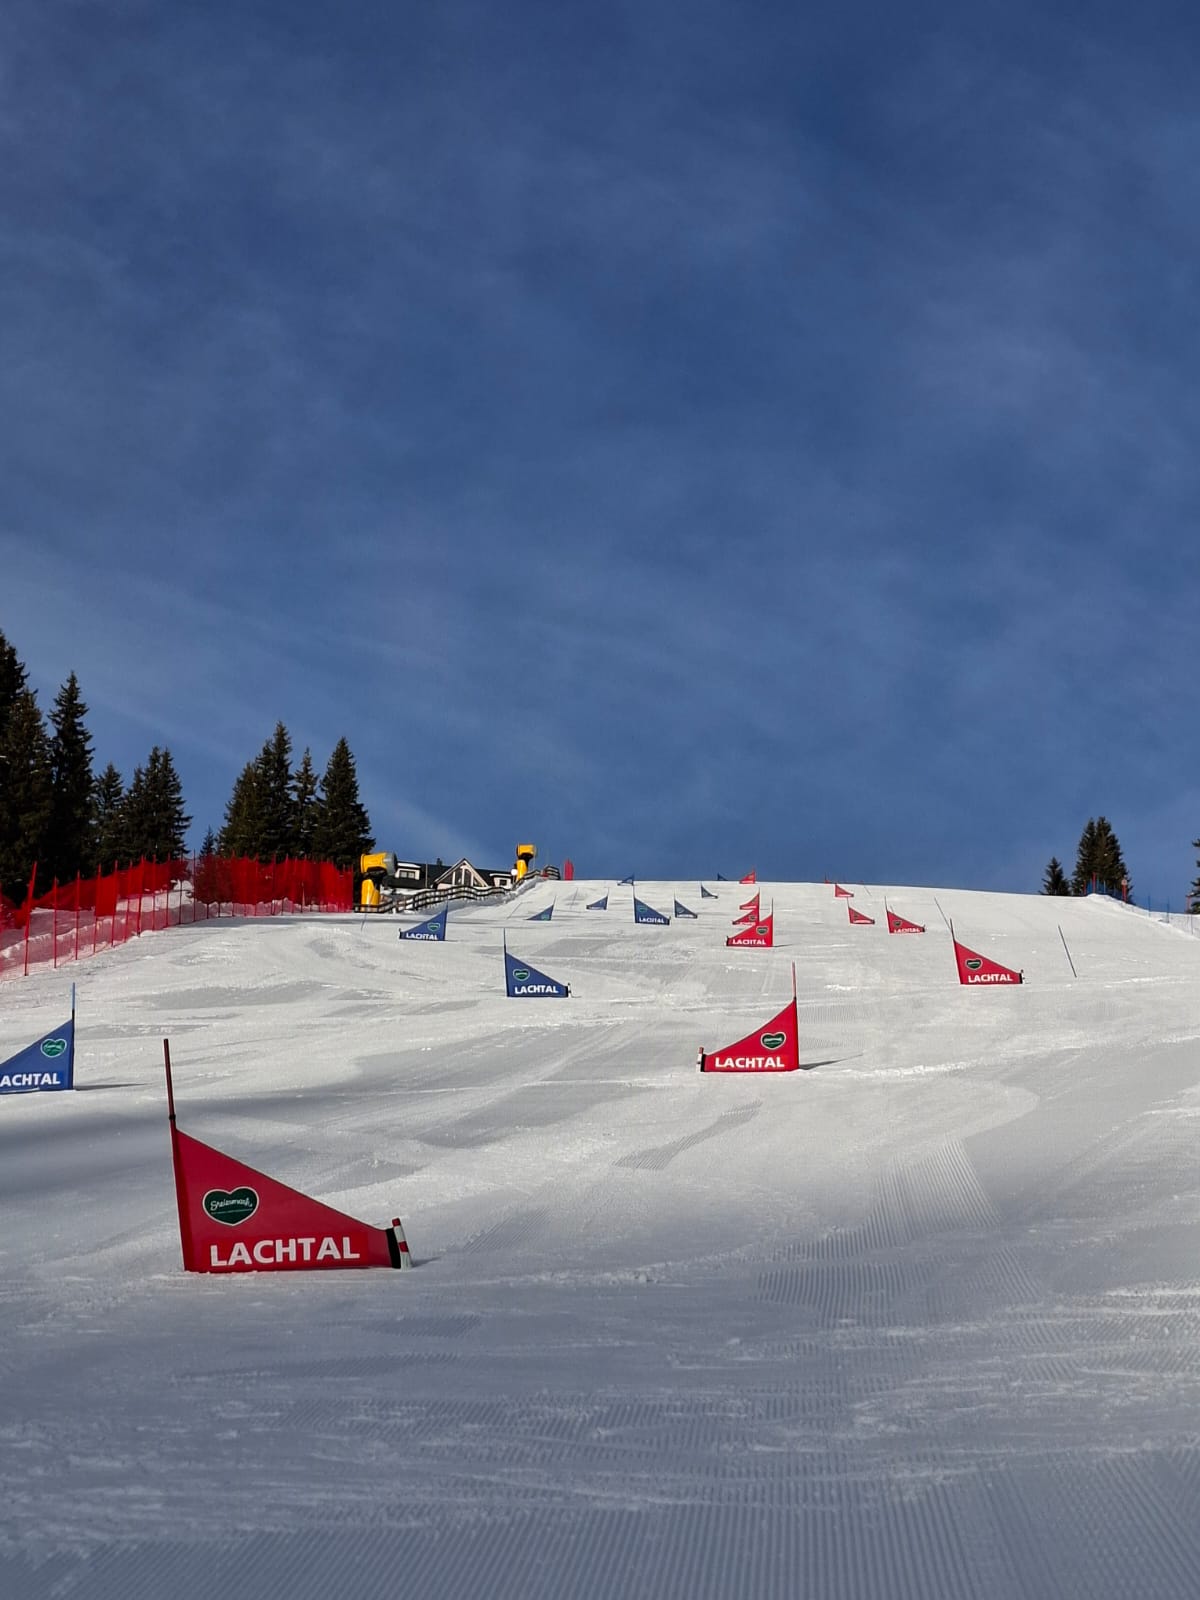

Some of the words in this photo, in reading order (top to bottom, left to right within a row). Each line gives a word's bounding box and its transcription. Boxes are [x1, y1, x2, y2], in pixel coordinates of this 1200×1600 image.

[968, 973, 1013, 983] LACHTAL
[514, 985, 559, 994] LACHTAL
[715, 1057, 785, 1068] LACHTAL
[209, 1236, 361, 1267] LACHTAL
